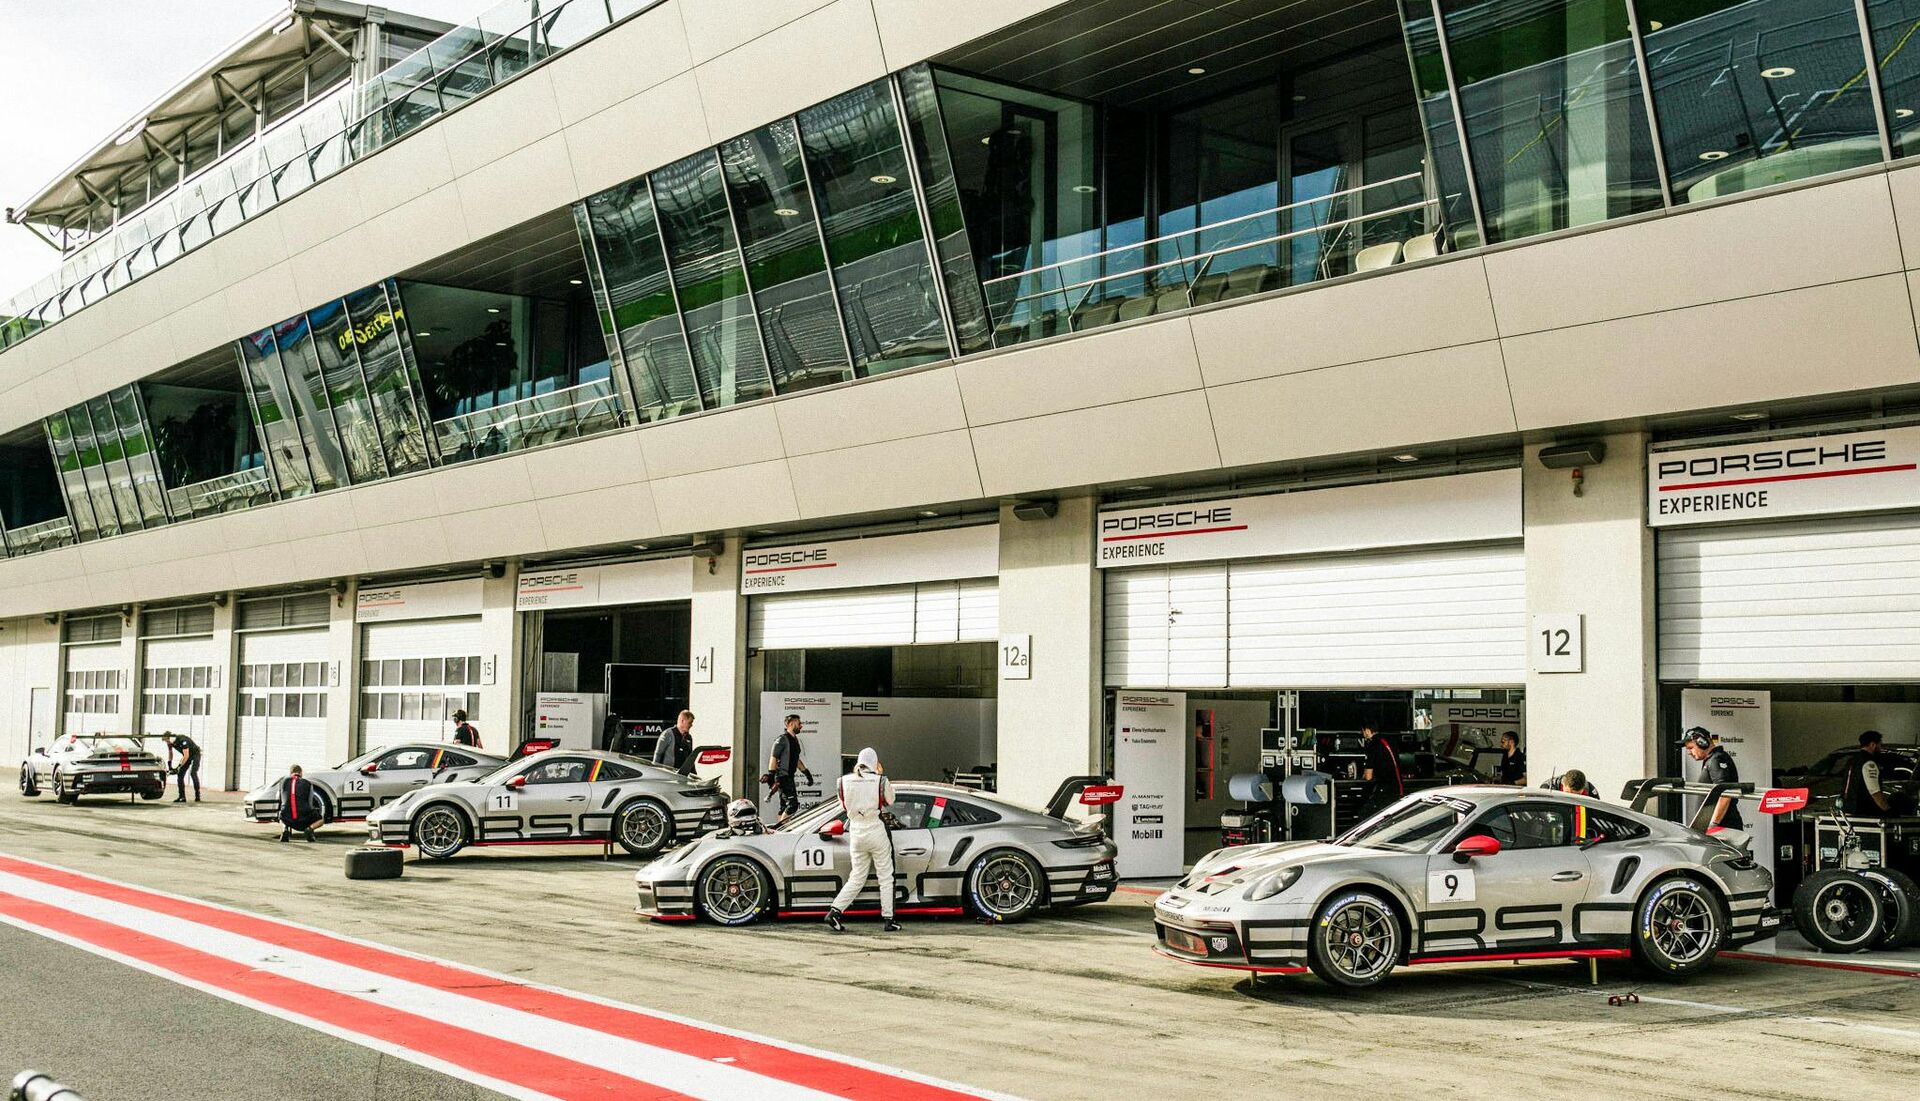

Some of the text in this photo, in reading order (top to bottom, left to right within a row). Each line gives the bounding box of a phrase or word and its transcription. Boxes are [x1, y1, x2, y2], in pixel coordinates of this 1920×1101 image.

[1658, 440, 1886, 480] PORSCHE
[1659, 490, 1769, 515] EXPERIENCE
[1102, 507, 1232, 533] PORSCHE
[745, 548, 828, 566] PORSCHE
[1102, 542, 1166, 560] EXPERIENCE
[520, 573, 578, 588] PORSCHE
[745, 575, 785, 589] EXPERIENCE
[1541, 628, 1571, 656] 12
[694, 655, 708, 673] 14
[1003, 645, 1028, 667] 12a
[483, 661, 492, 676] 15
[1710, 697, 1756, 705] PORSCHE
[348, 780, 364, 792] 12
[496, 795, 511, 808] 11
[1132, 829, 1154, 839] Mobil
[801, 849, 825, 866] 10
[1443, 874, 1460, 897] 9
